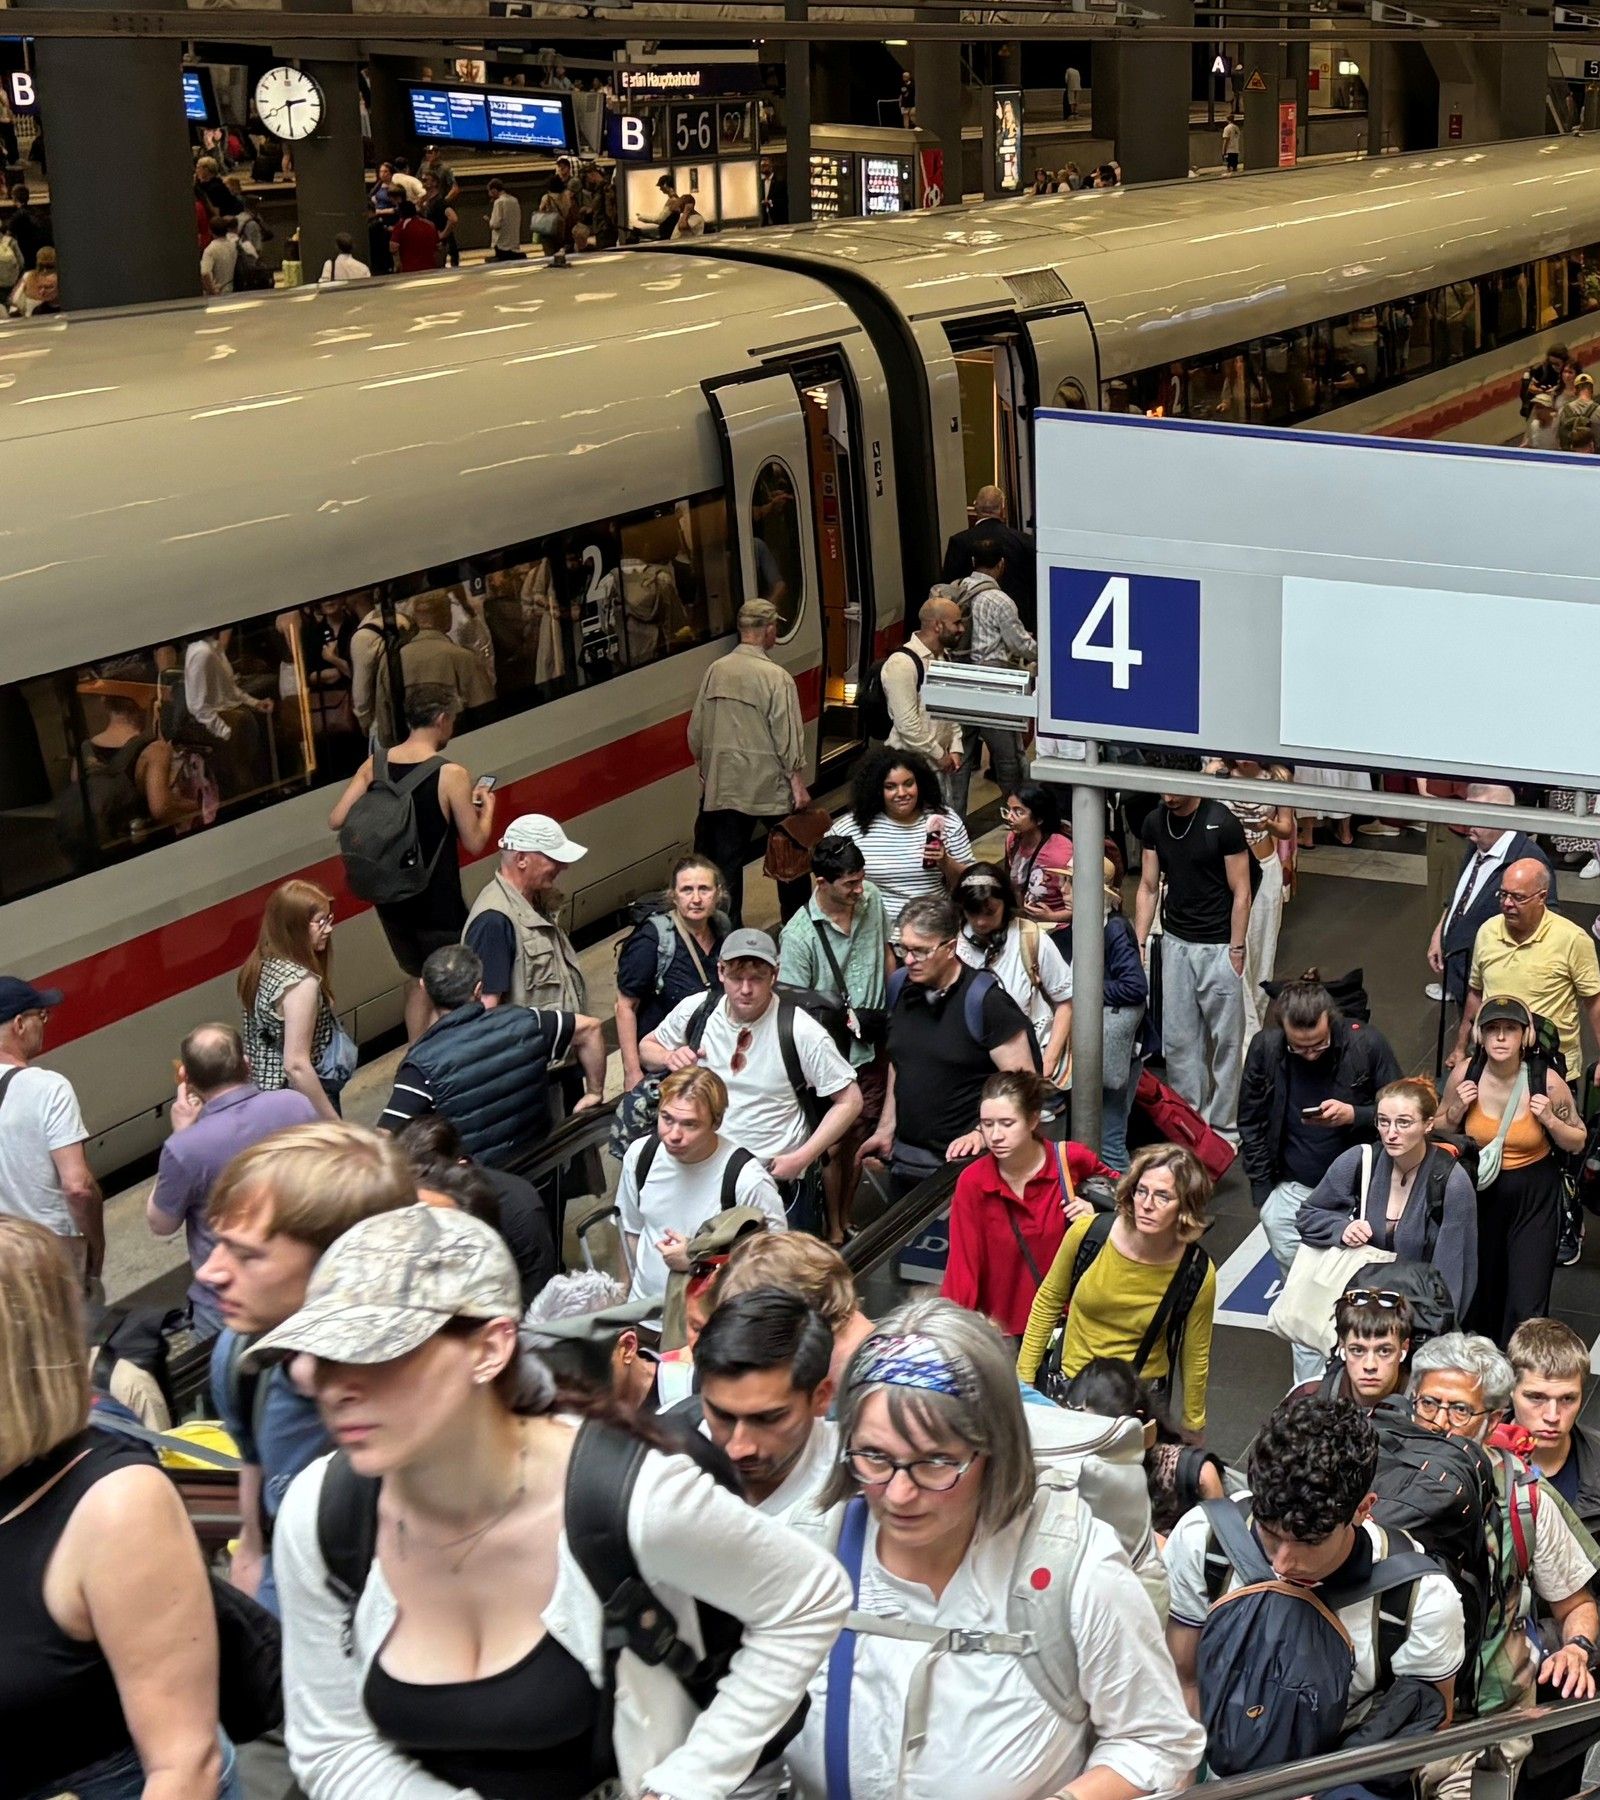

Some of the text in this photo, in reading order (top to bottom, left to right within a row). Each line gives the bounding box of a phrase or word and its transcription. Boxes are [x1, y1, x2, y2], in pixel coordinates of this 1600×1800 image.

[622, 71, 700, 90] Berlin Hauptbahnhof
[1211, 56, 1225, 73] A
[1590, 61, 1599, 74] 5
[11, 72, 36, 106] B
[621, 116, 645, 151] B
[676, 111, 711, 150] 5-6
[582, 545, 603, 603] 2
[1071, 577, 1143, 690] 4
